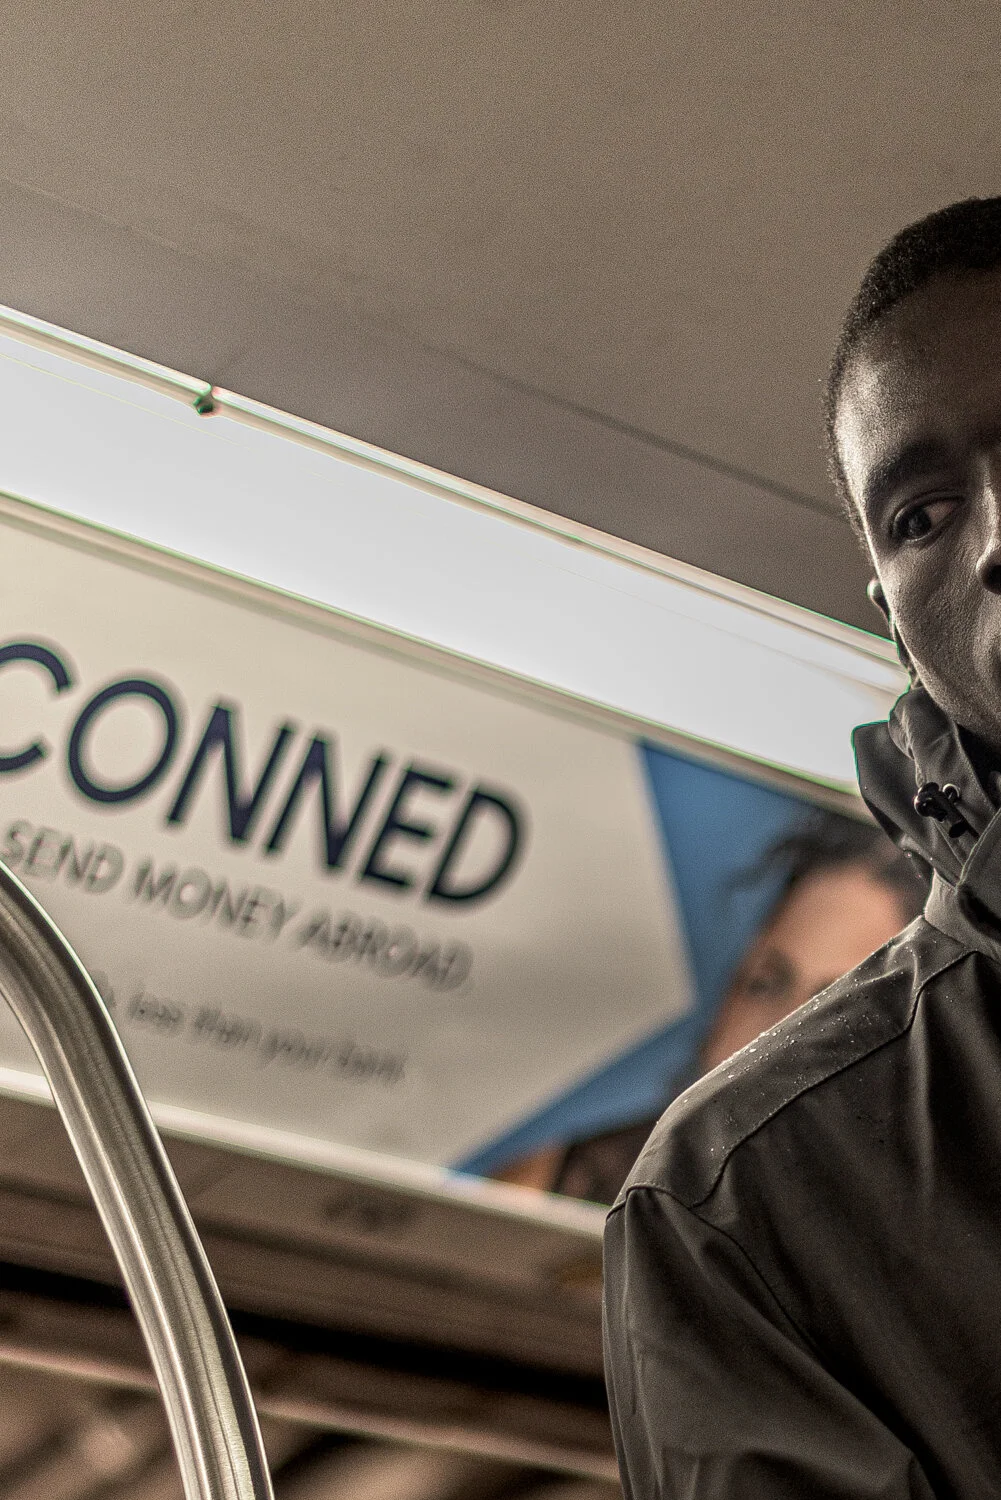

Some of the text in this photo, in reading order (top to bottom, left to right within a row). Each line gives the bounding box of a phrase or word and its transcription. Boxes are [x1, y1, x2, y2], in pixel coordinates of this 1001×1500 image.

[0, 642, 521, 902] CONNED
[2, 819, 474, 993] SEND MONEY ABROAD
